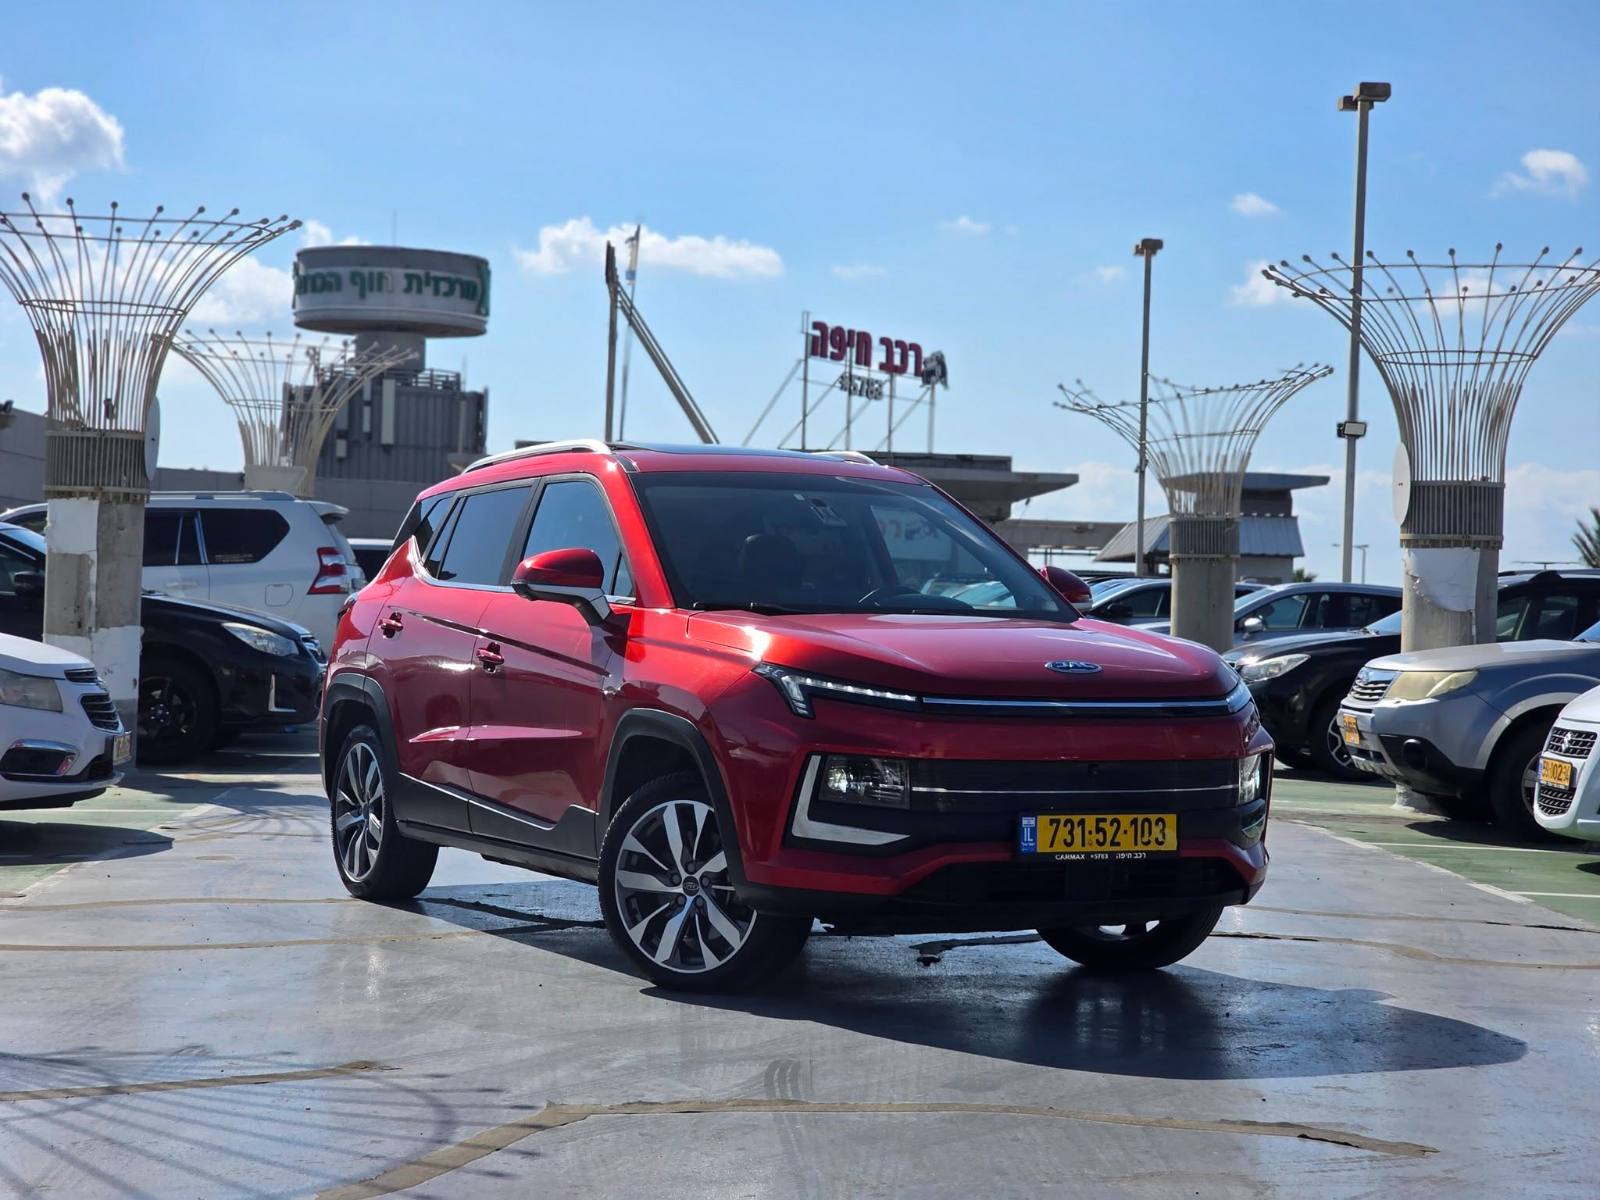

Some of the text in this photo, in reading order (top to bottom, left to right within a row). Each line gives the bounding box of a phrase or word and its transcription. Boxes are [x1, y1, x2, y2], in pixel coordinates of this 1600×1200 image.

[810, 320, 923, 378] רכב חיפה
[1023, 827, 1034, 842] IL
[1055, 853, 1086, 861] CARMAX
[1115, 852, 1132, 860] חיפה
